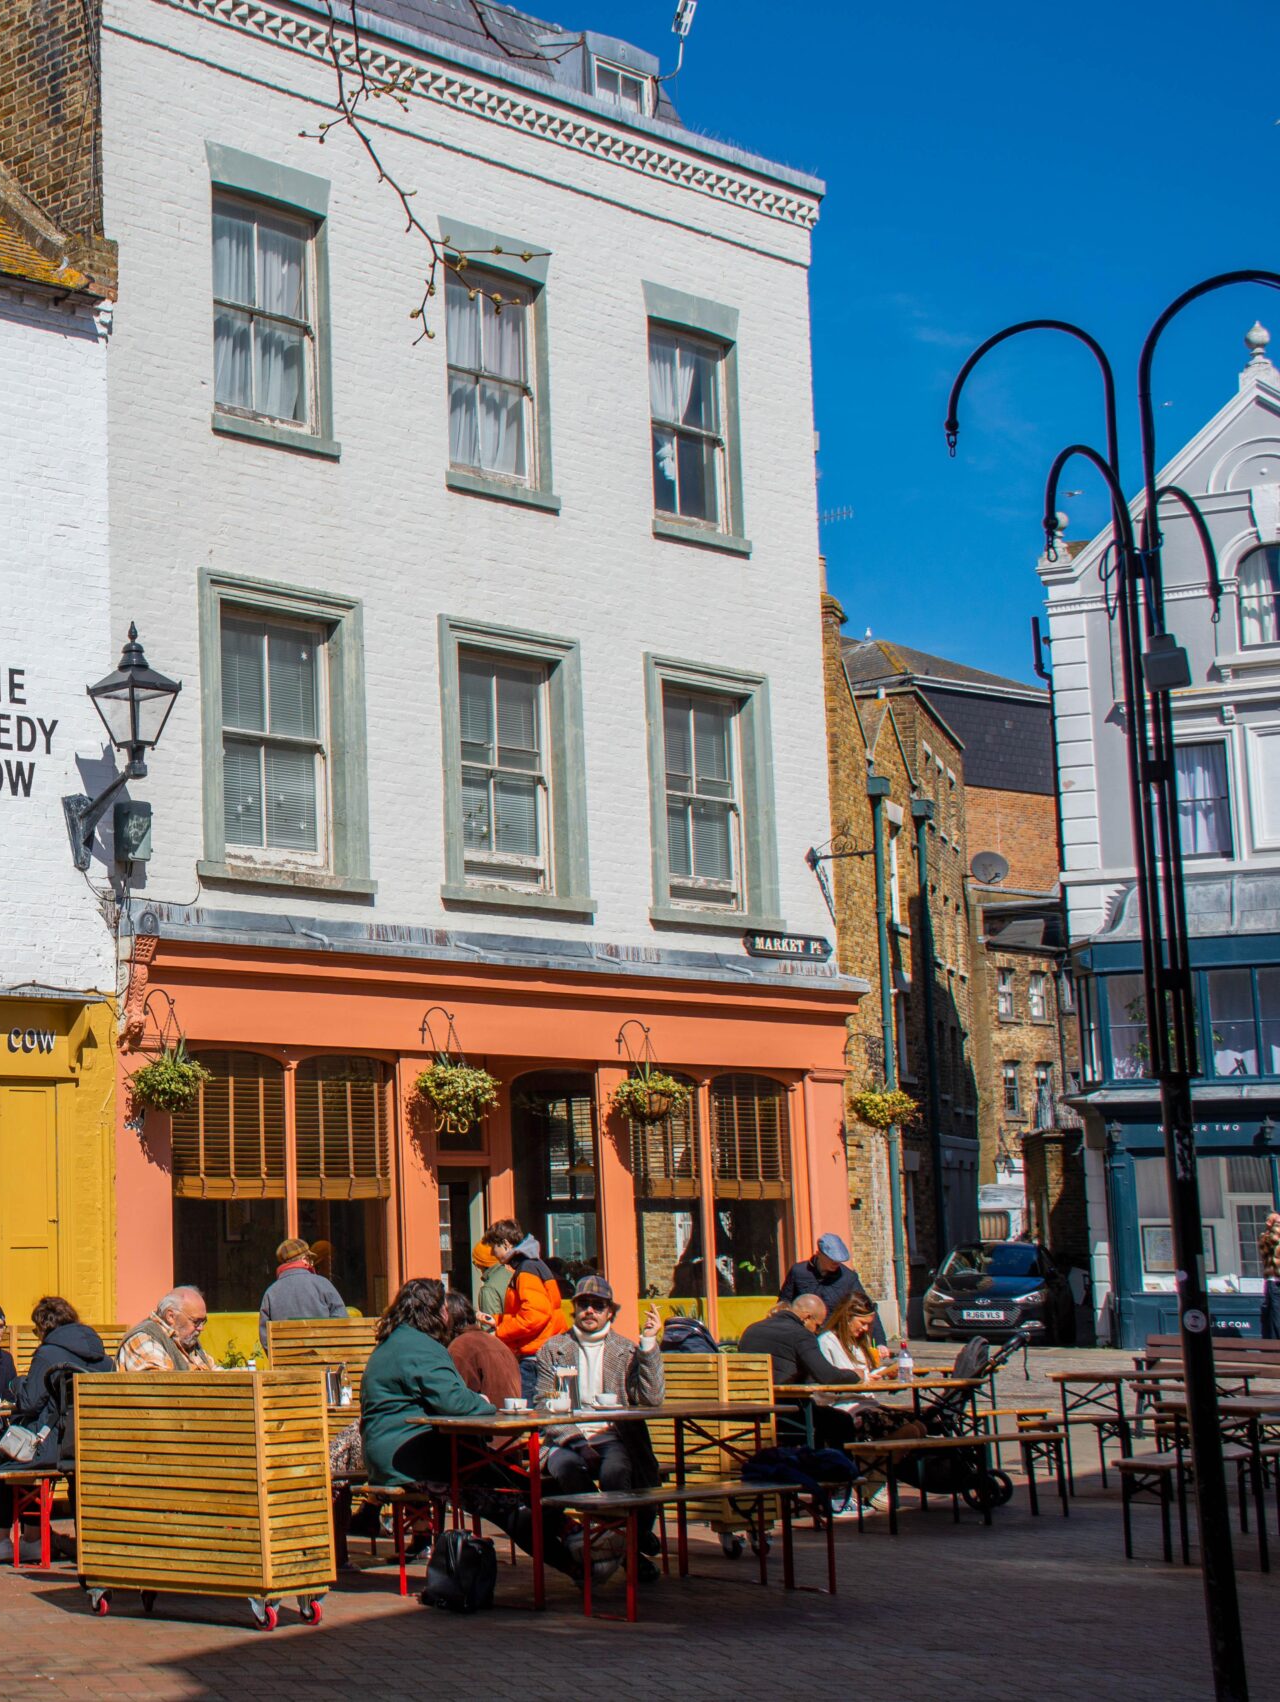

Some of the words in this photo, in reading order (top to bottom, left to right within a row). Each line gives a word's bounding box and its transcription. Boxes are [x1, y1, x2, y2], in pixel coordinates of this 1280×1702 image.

[755, 936, 805, 953] MARKET
[8, 1027, 56, 1054] COW
[1215, 1123, 1241, 1132] TWO
[966, 1311, 985, 1319] RJ66
[986, 1311, 1001, 1319] VLS
